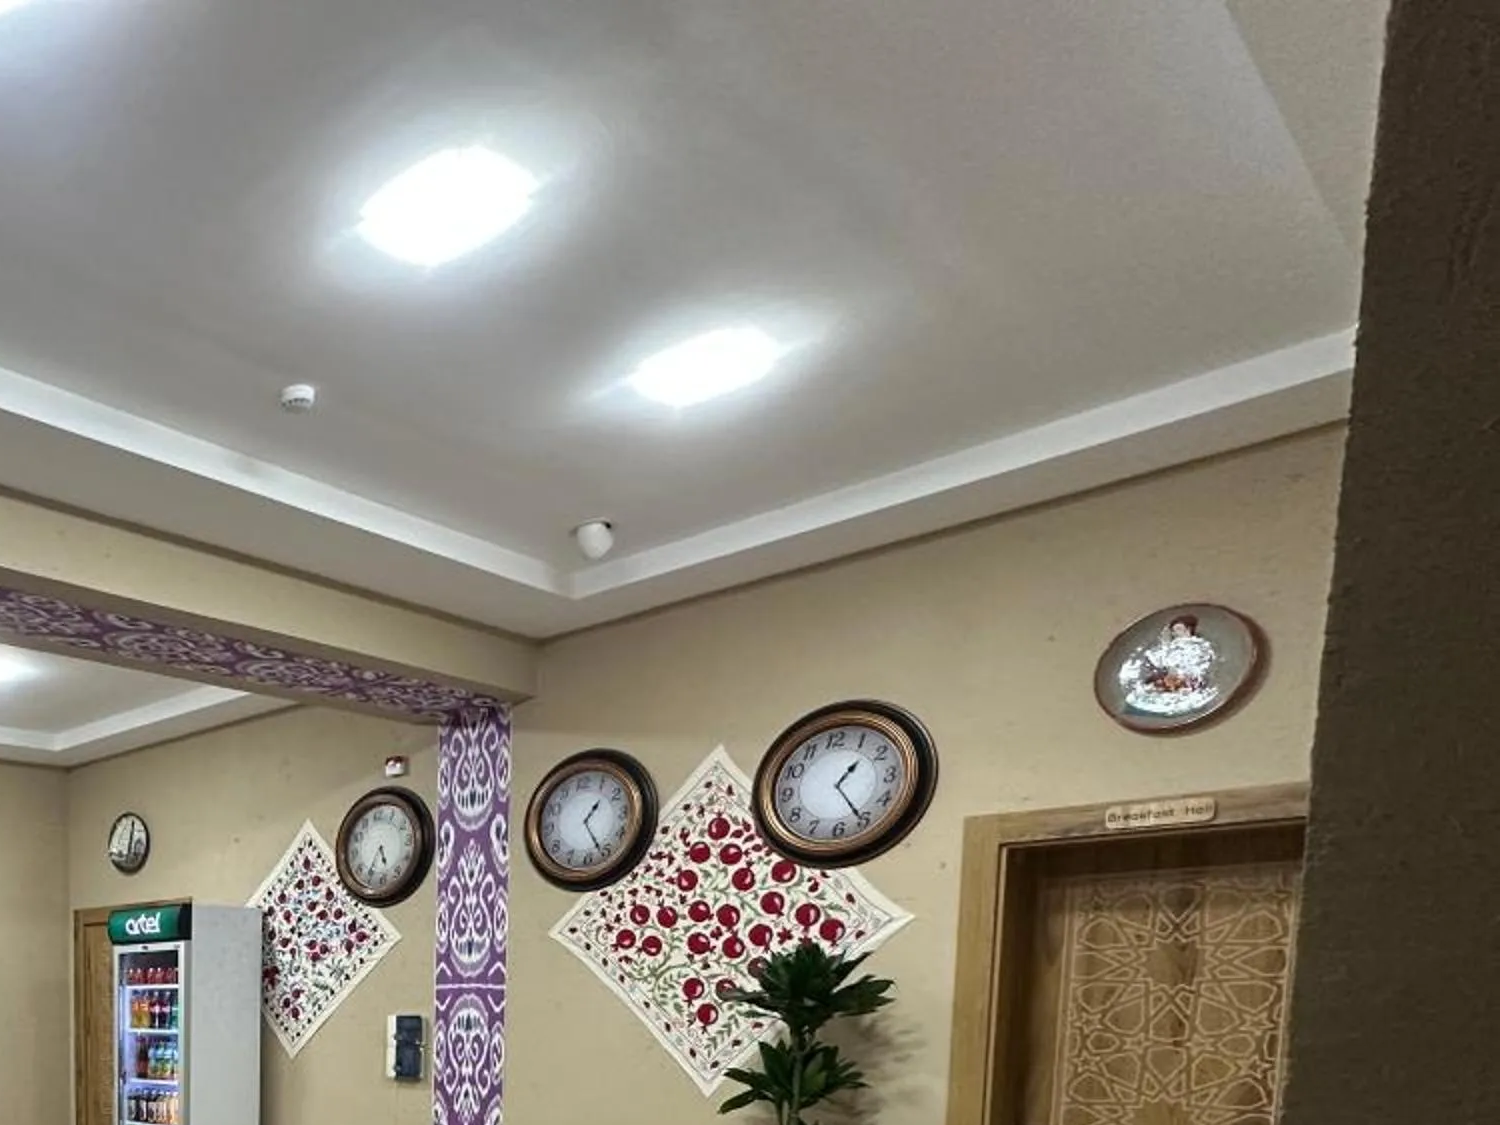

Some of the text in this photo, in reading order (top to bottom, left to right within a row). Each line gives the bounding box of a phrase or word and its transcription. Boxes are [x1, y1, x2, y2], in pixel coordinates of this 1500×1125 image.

[825, 731, 845, 750] 12
[858, 732, 866, 748] 1
[874, 745, 888, 761] 2
[786, 763, 804, 780] 10
[884, 766, 896, 784] 3
[782, 788, 794, 802] 9
[876, 790, 891, 807] 4
[790, 808, 802, 823] 8
[1108, 808, 1176, 822] Breakfast
[809, 820, 820, 835] 7
[832, 822, 845, 837] 6
